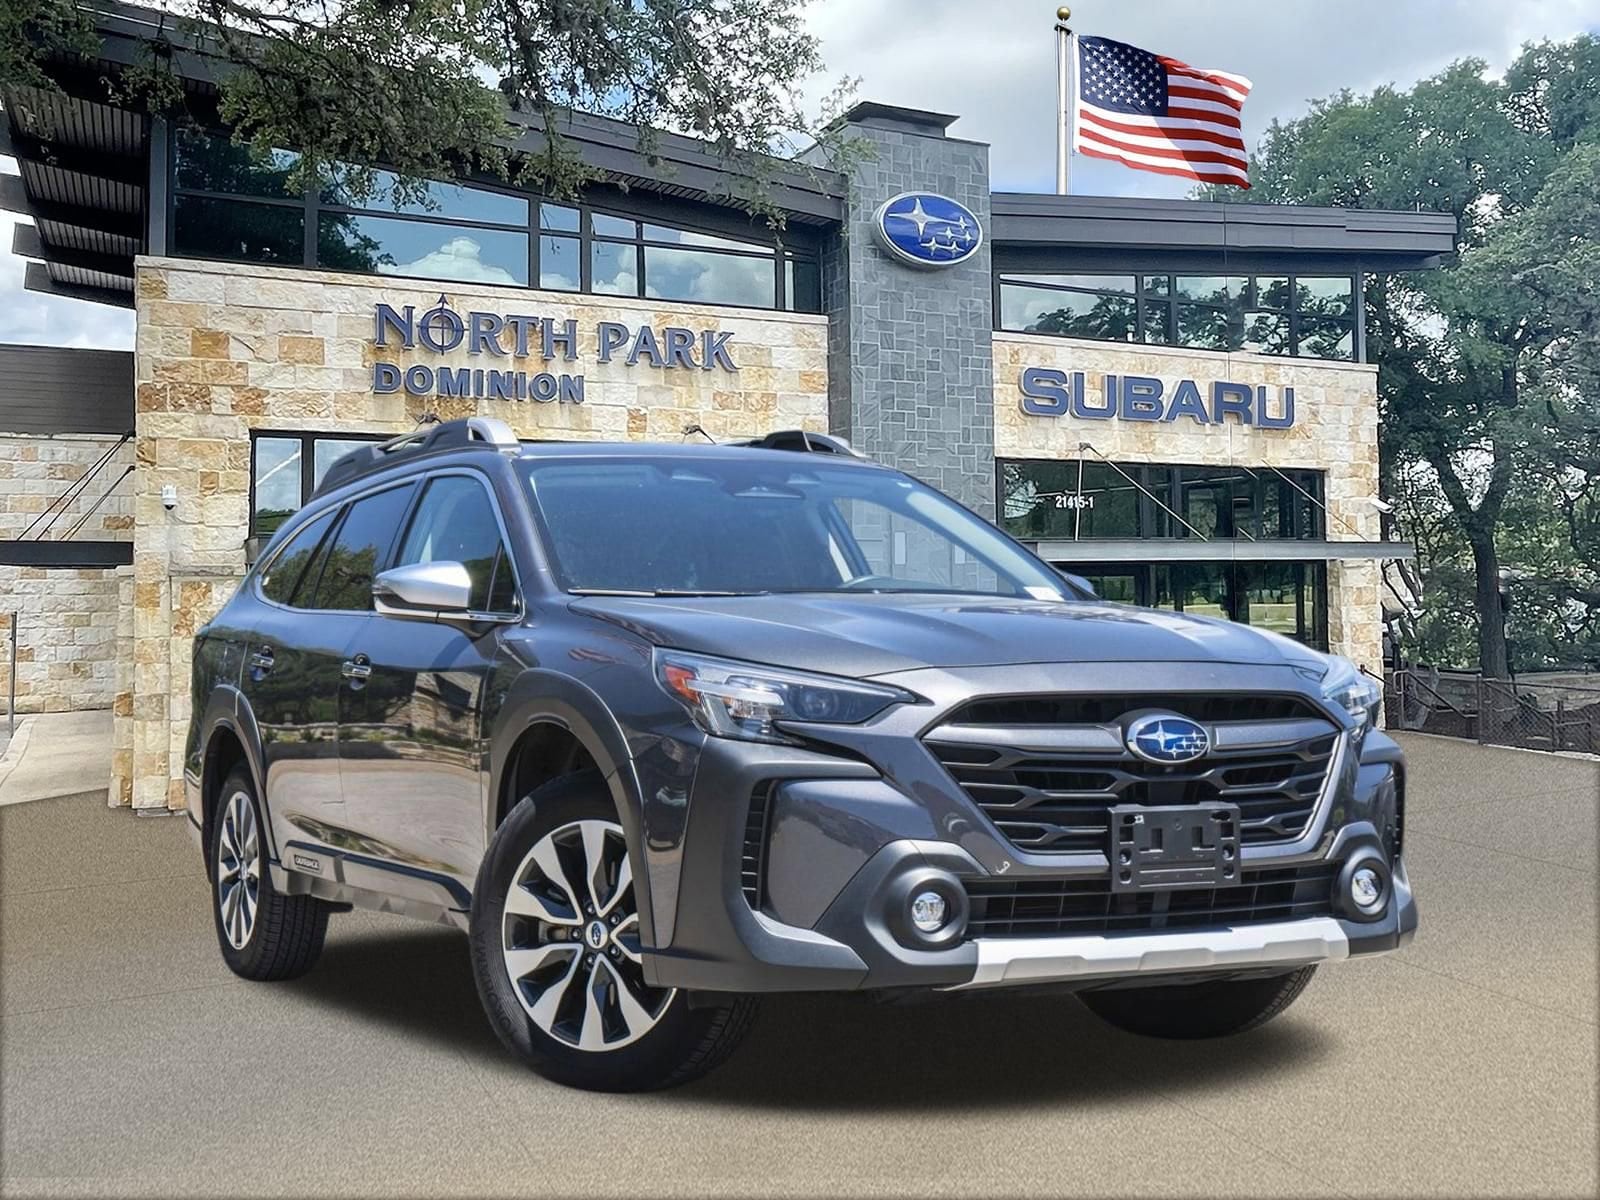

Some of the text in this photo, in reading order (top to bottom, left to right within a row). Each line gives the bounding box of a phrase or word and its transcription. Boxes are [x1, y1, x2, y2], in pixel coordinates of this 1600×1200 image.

[375, 298, 742, 373] NORTH PARK
[372, 362, 585, 405] DOMINION
[1019, 367, 1295, 430] SUBARU
